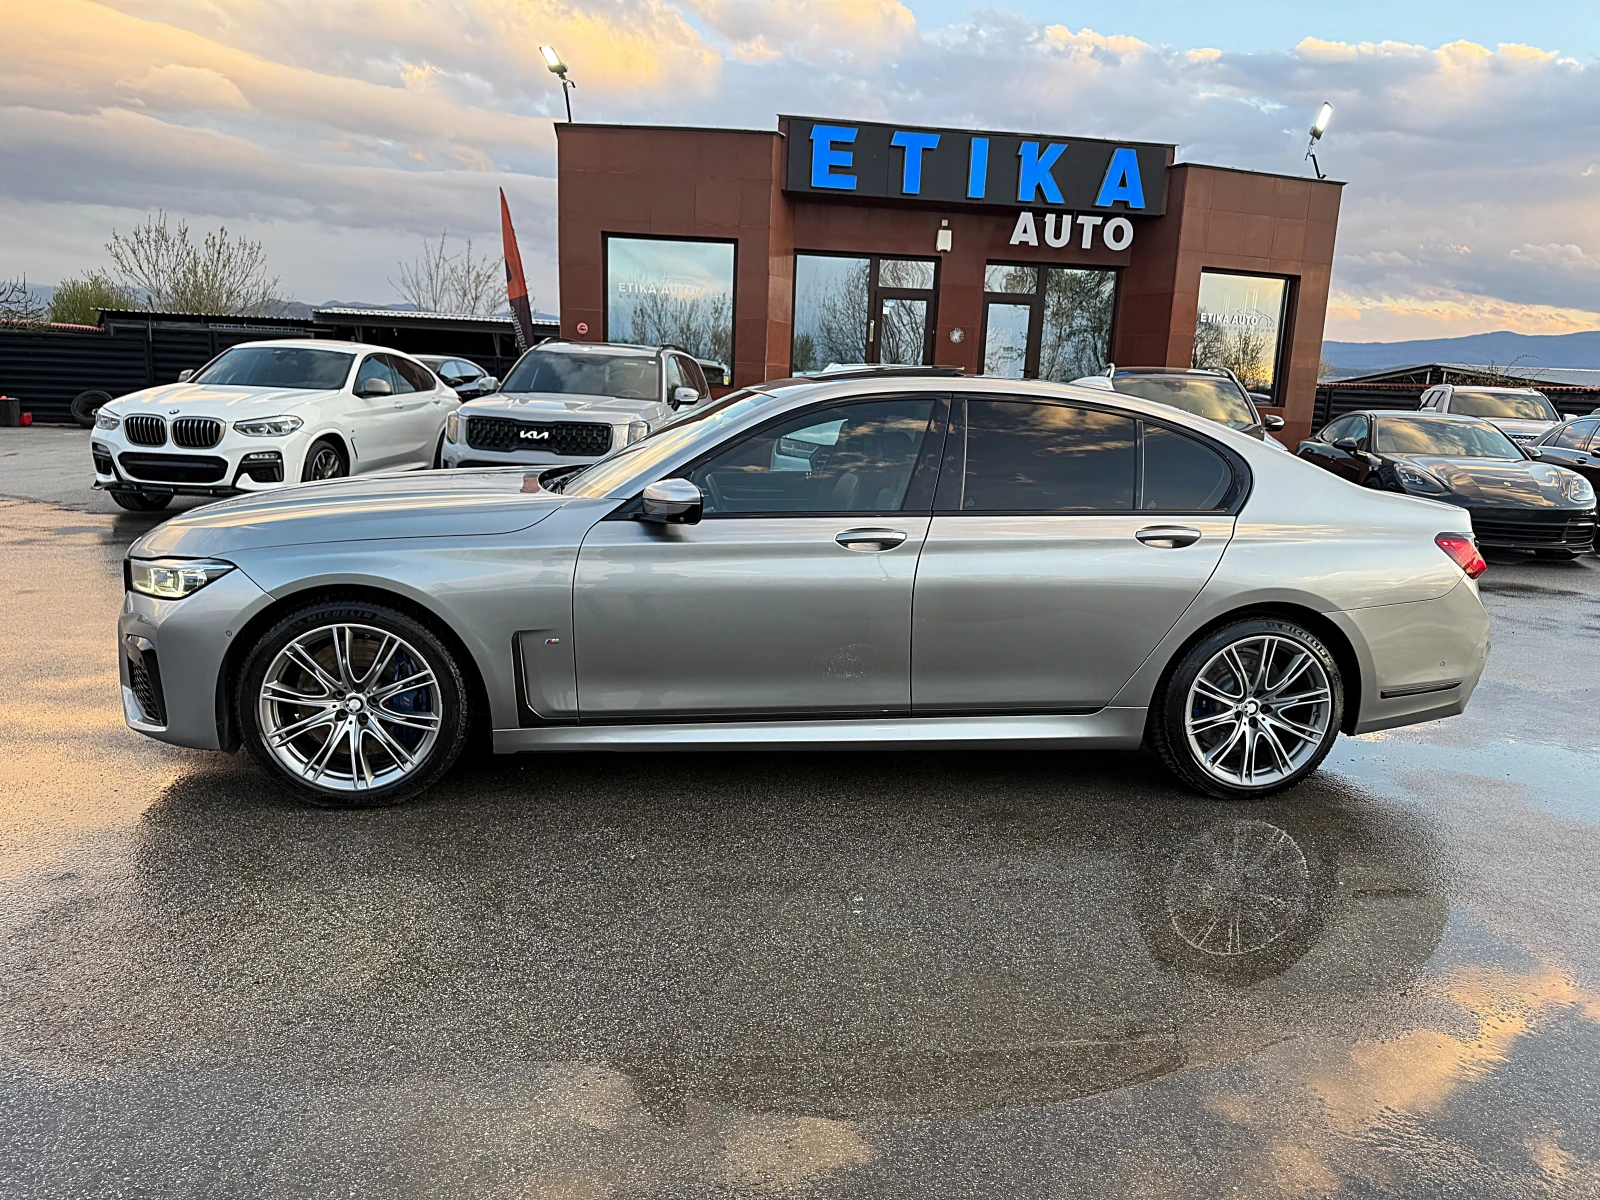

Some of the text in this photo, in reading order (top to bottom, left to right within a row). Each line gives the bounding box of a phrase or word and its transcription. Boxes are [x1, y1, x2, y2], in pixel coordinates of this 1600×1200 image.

[810, 124, 1146, 209] ETIKA
[1009, 211, 1134, 251] AUTO
[618, 282, 697, 296] ETIKA AUTO
[1200, 312, 1258, 325] ETIKA AUTO
[306, 610, 373, 621] MICHELIN
[1282, 625, 1327, 656] MICHELIN
